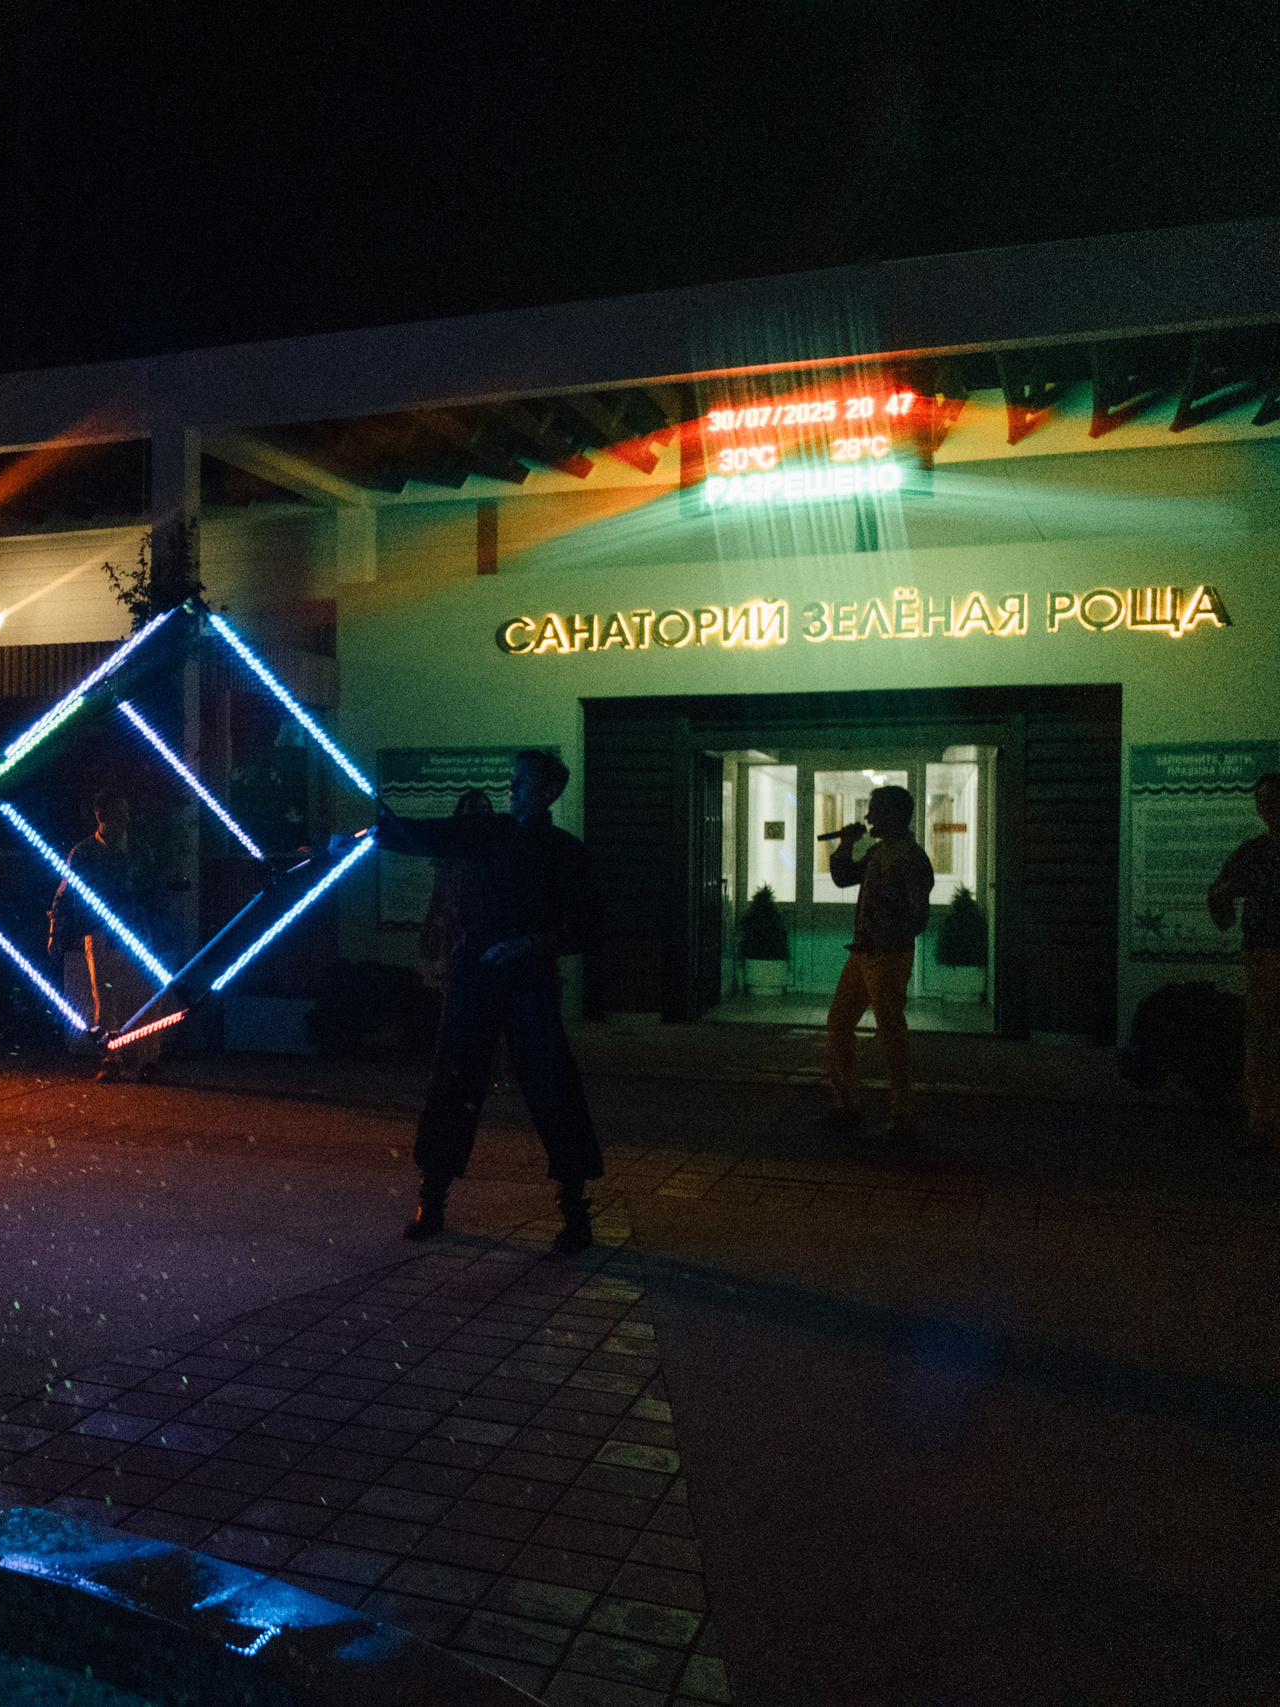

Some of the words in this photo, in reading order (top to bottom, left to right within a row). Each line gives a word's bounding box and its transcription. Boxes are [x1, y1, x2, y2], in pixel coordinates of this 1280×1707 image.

[707, 401, 836, 432] 30/07/2025
[845, 397, 873, 420] 20
[885, 392, 915, 415] 47
[705, 463, 902, 503] РАЗРЕШЕНО
[496, 598, 788, 653] САНАТОРИЙ
[802, 587, 1028, 643] ЗЕЛЁНАЯ
[1047, 585, 1233, 638] РОЩА
